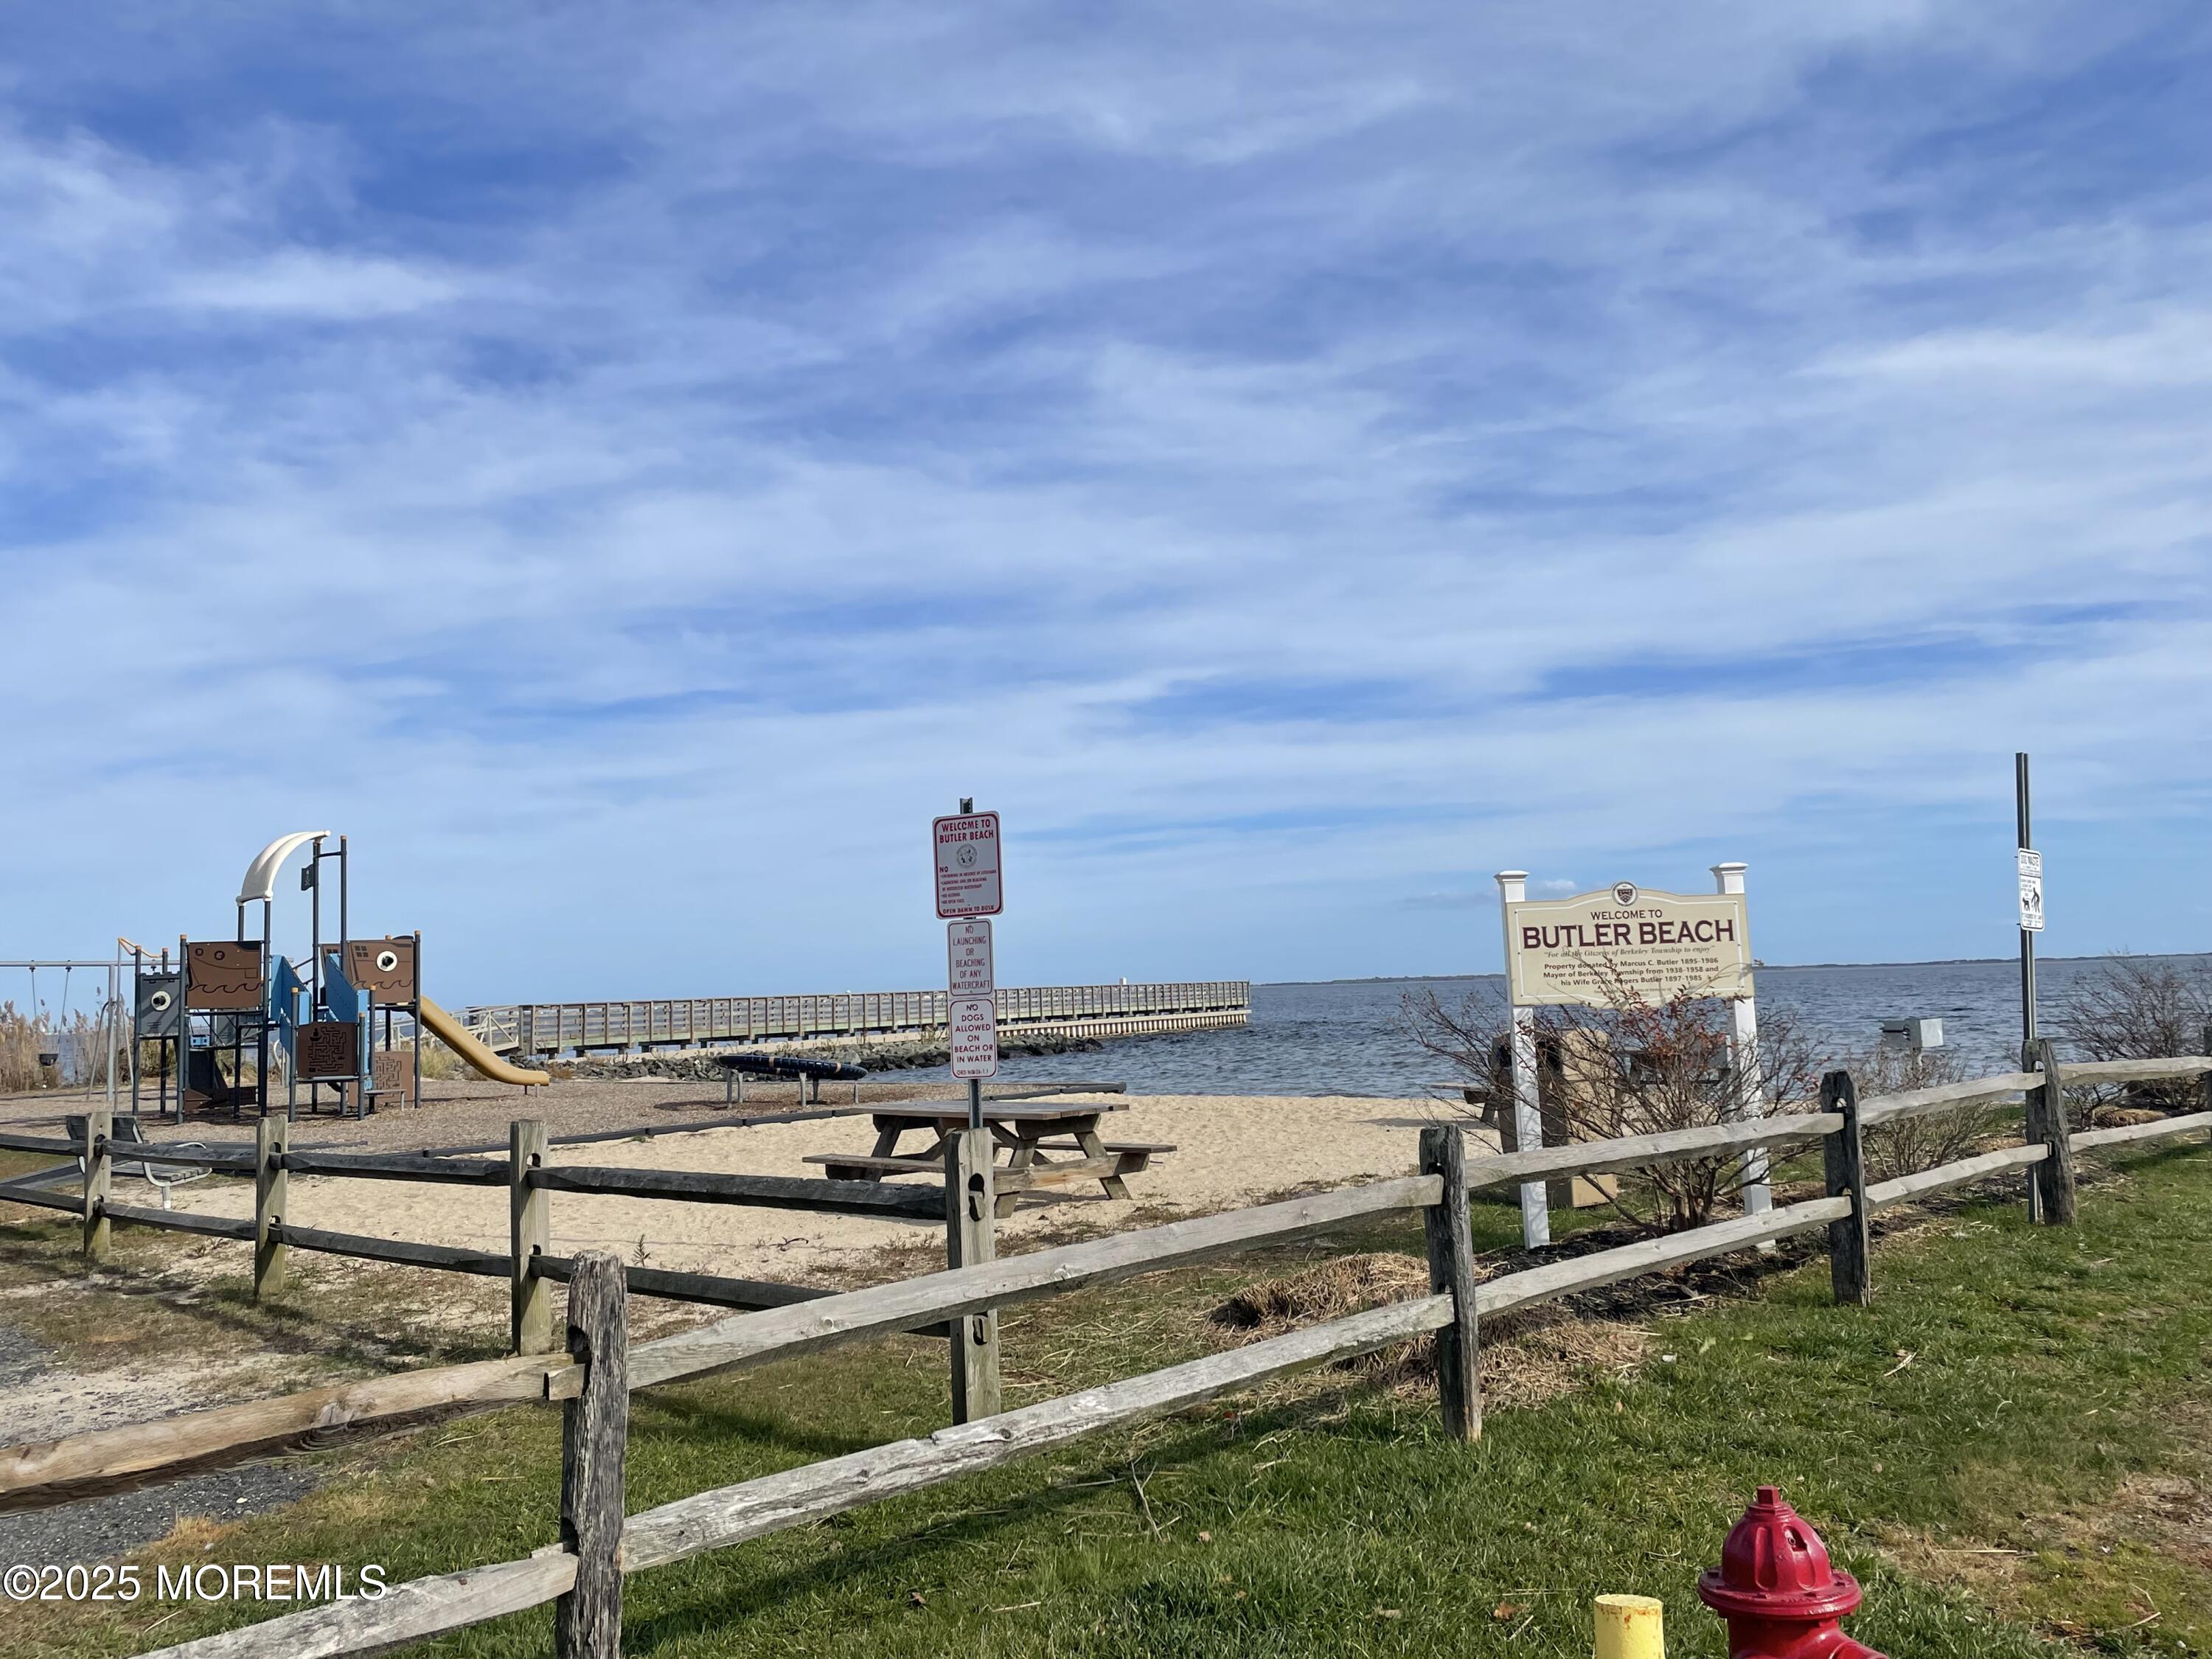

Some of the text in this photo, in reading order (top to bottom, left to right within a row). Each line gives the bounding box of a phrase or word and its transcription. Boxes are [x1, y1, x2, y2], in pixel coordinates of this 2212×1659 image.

[942, 818, 991, 832] WELCOME TO
[939, 830, 994, 844] BUTLER BEACH
[1590, 909, 1663, 921] WELCOME TO
[965, 925, 973, 934] NO
[1522, 919, 1734, 949] BUTLER BEACH
[953, 936, 987, 946] LAUNCHING
[966, 947, 974, 956] OR
[956, 959, 985, 968] BEACHING
[959, 970, 981, 978] OF ANY
[952, 980, 990, 990] WATERCRAFT
[966, 1004, 978, 1012] NO
[961, 1014, 984, 1022] DOGS
[955, 1023, 991, 1032] ALLOWED
[954, 1045, 980, 1053] BEACH
